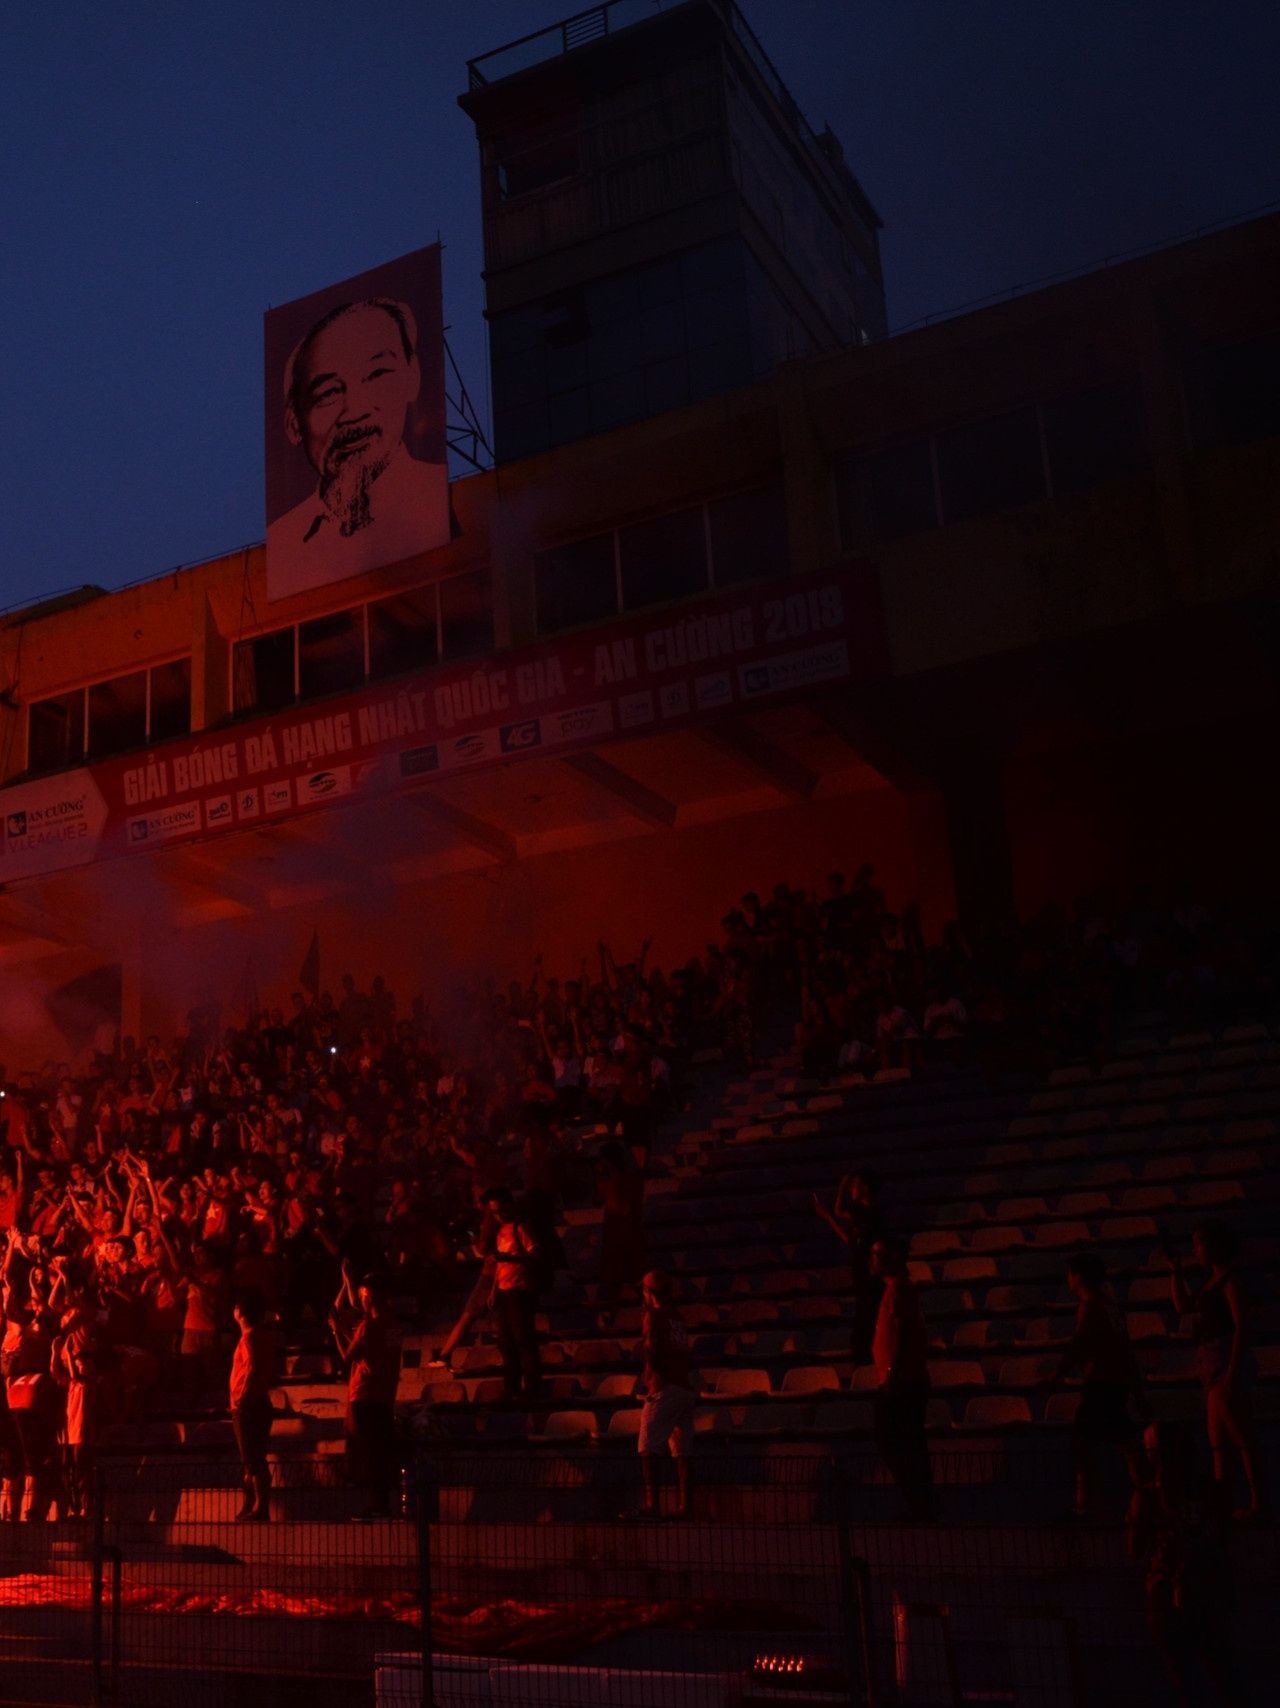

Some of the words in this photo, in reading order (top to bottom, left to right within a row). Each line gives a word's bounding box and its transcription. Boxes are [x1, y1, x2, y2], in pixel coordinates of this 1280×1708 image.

[122, 754, 168, 806] GIẢI
[173, 742, 239, 794] BÓNG
[244, 726, 278, 775] ĐÁ
[282, 711, 353, 769] HẠNG
[358, 683, 427, 747] NHẤT
[433, 662, 509, 728] QUỐC
[515, 654, 567, 705] GIA
[593, 637, 638, 687] AN
[644, 607, 755, 673] CƯỜNG
[762, 584, 845, 644] 2018
[506, 723, 537, 746] 4G
[29, 809, 43, 823] AN
